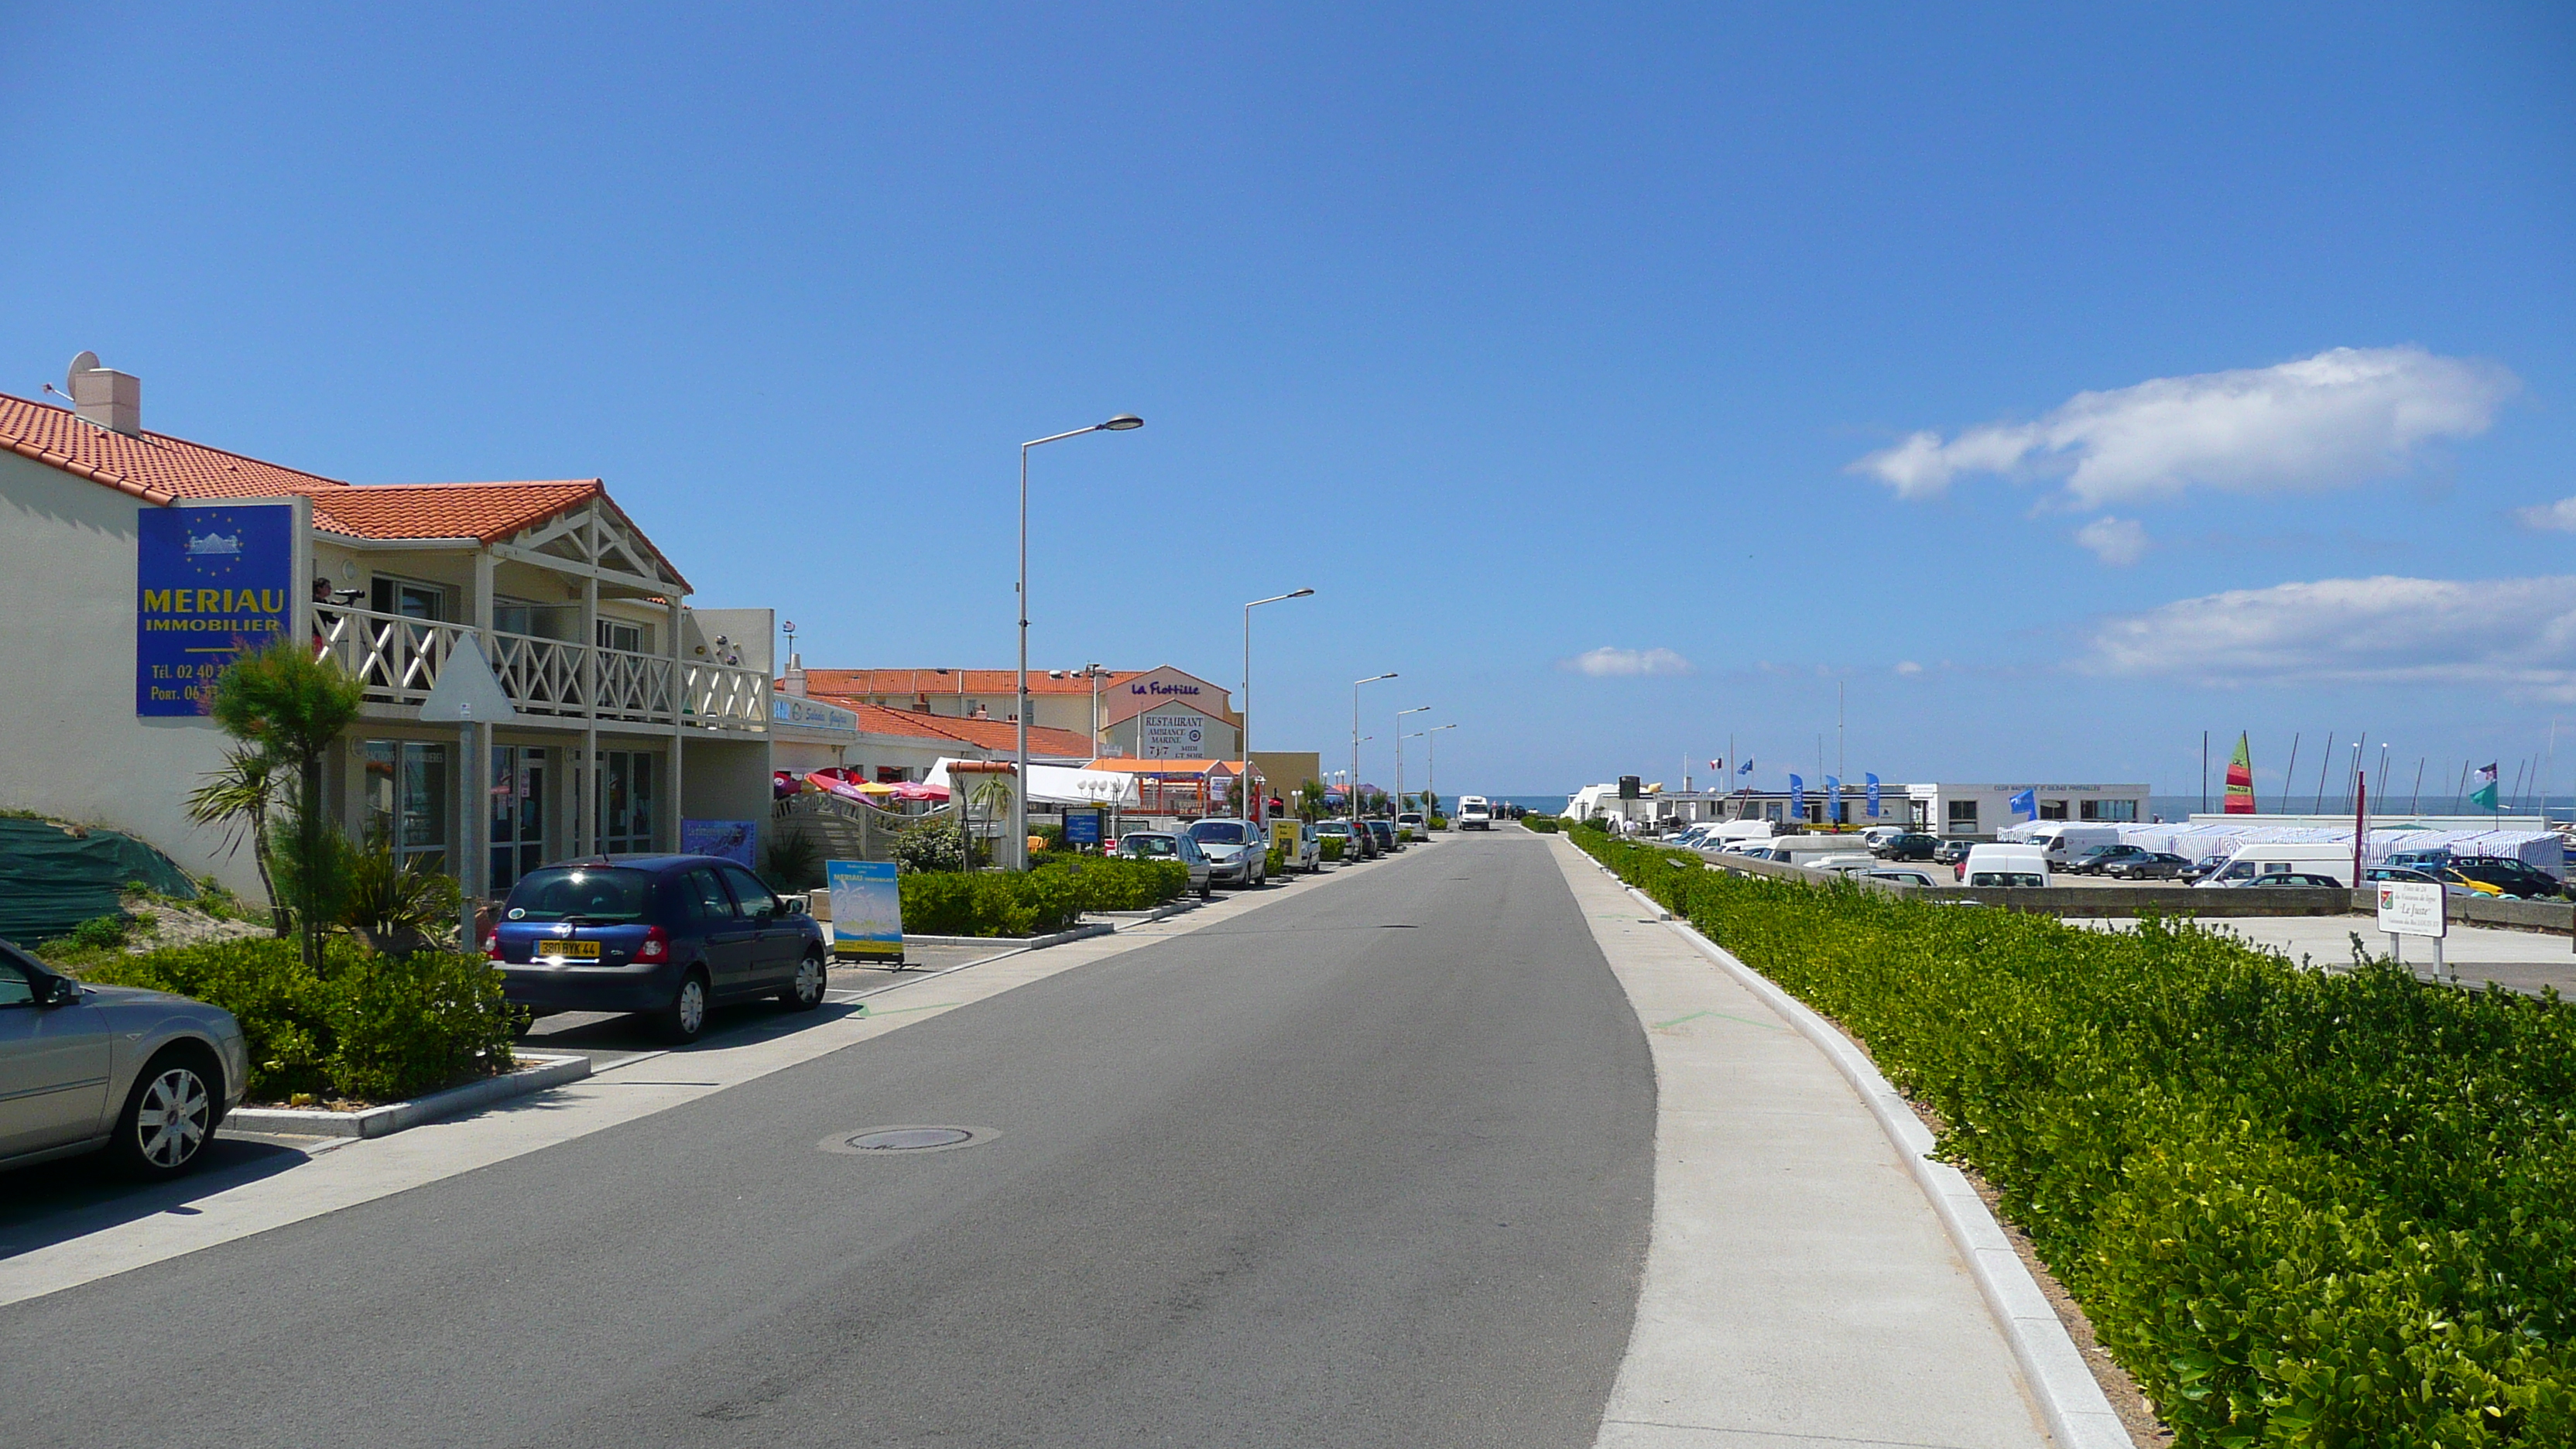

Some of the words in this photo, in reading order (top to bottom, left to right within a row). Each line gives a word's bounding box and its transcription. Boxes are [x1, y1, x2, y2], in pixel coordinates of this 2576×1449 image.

[144, 589, 284, 613] MERIAU
[146, 619, 279, 632] IMMOBILIER
[176, 664, 193, 679] 02
[197, 664, 214, 679] 40
[184, 686, 200, 701] 06
[1149, 681, 1201, 695] Flottille
[1146, 717, 1204, 727] RESTAURANT
[834, 873, 863, 882] MERIAU
[582, 944, 595, 954] 44
